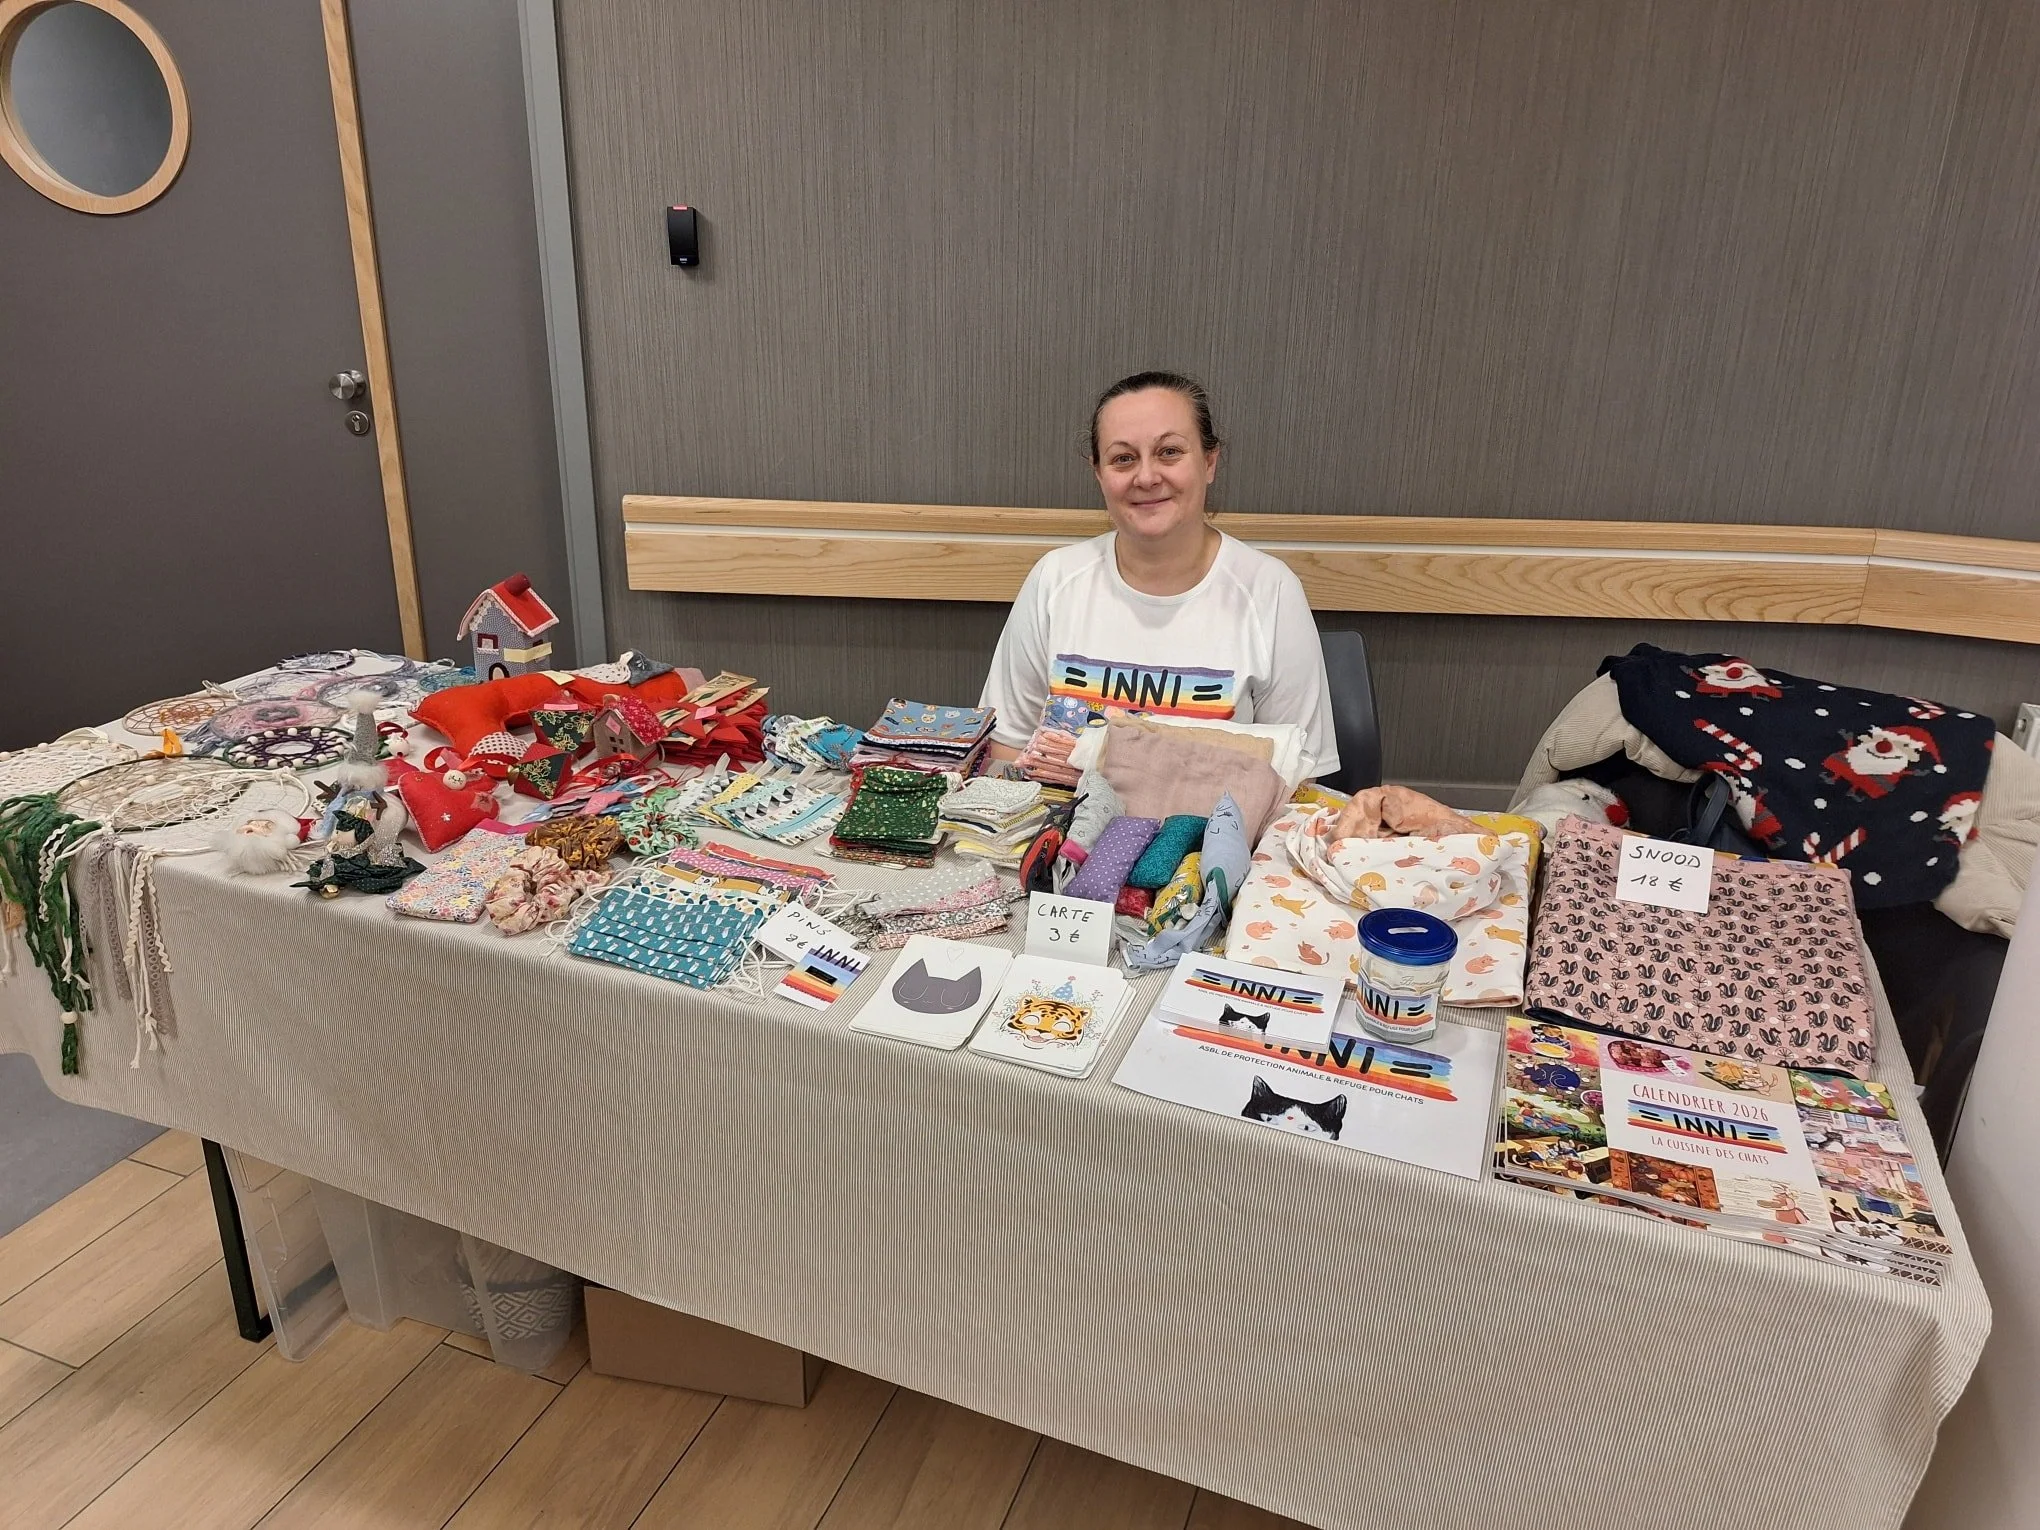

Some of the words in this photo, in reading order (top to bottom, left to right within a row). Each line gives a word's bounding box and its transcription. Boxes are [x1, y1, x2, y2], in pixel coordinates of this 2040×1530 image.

[1101, 667, 1182, 708] INNI
[1629, 845, 1701, 869] SNOOD
[1630, 874, 1659, 887] 18
[1668, 877, 1683, 892] €
[1037, 903, 1094, 922] CARTE
[1049, 927, 1061, 942] 3
[1069, 929, 1080, 943] €
[813, 944, 861, 972] INNI
[1230, 979, 1286, 1003] INNI
[1198, 1045, 1220, 1055] ASBL
[1221, 1050, 1233, 1058] DE
[1233, 1053, 1285, 1071] PROTECTION
[1286, 1066, 1327, 1081] ANIMALE
[1333, 1077, 1368, 1091] REFUGE
[1369, 1086, 1394, 1098] POUR
[1394, 1093, 1424, 1105] CHATS
[1633, 1083, 1726, 1114] CALENDRIER
[1733, 1102, 1769, 1122] 2026
[1673, 1113, 1738, 1140] INNI
[1651, 1135, 1664, 1147] LA
[1667, 1139, 1712, 1155] CUISINE
[1715, 1148, 1734, 1160] DES
[1738, 1152, 1769, 1165] CHATS
